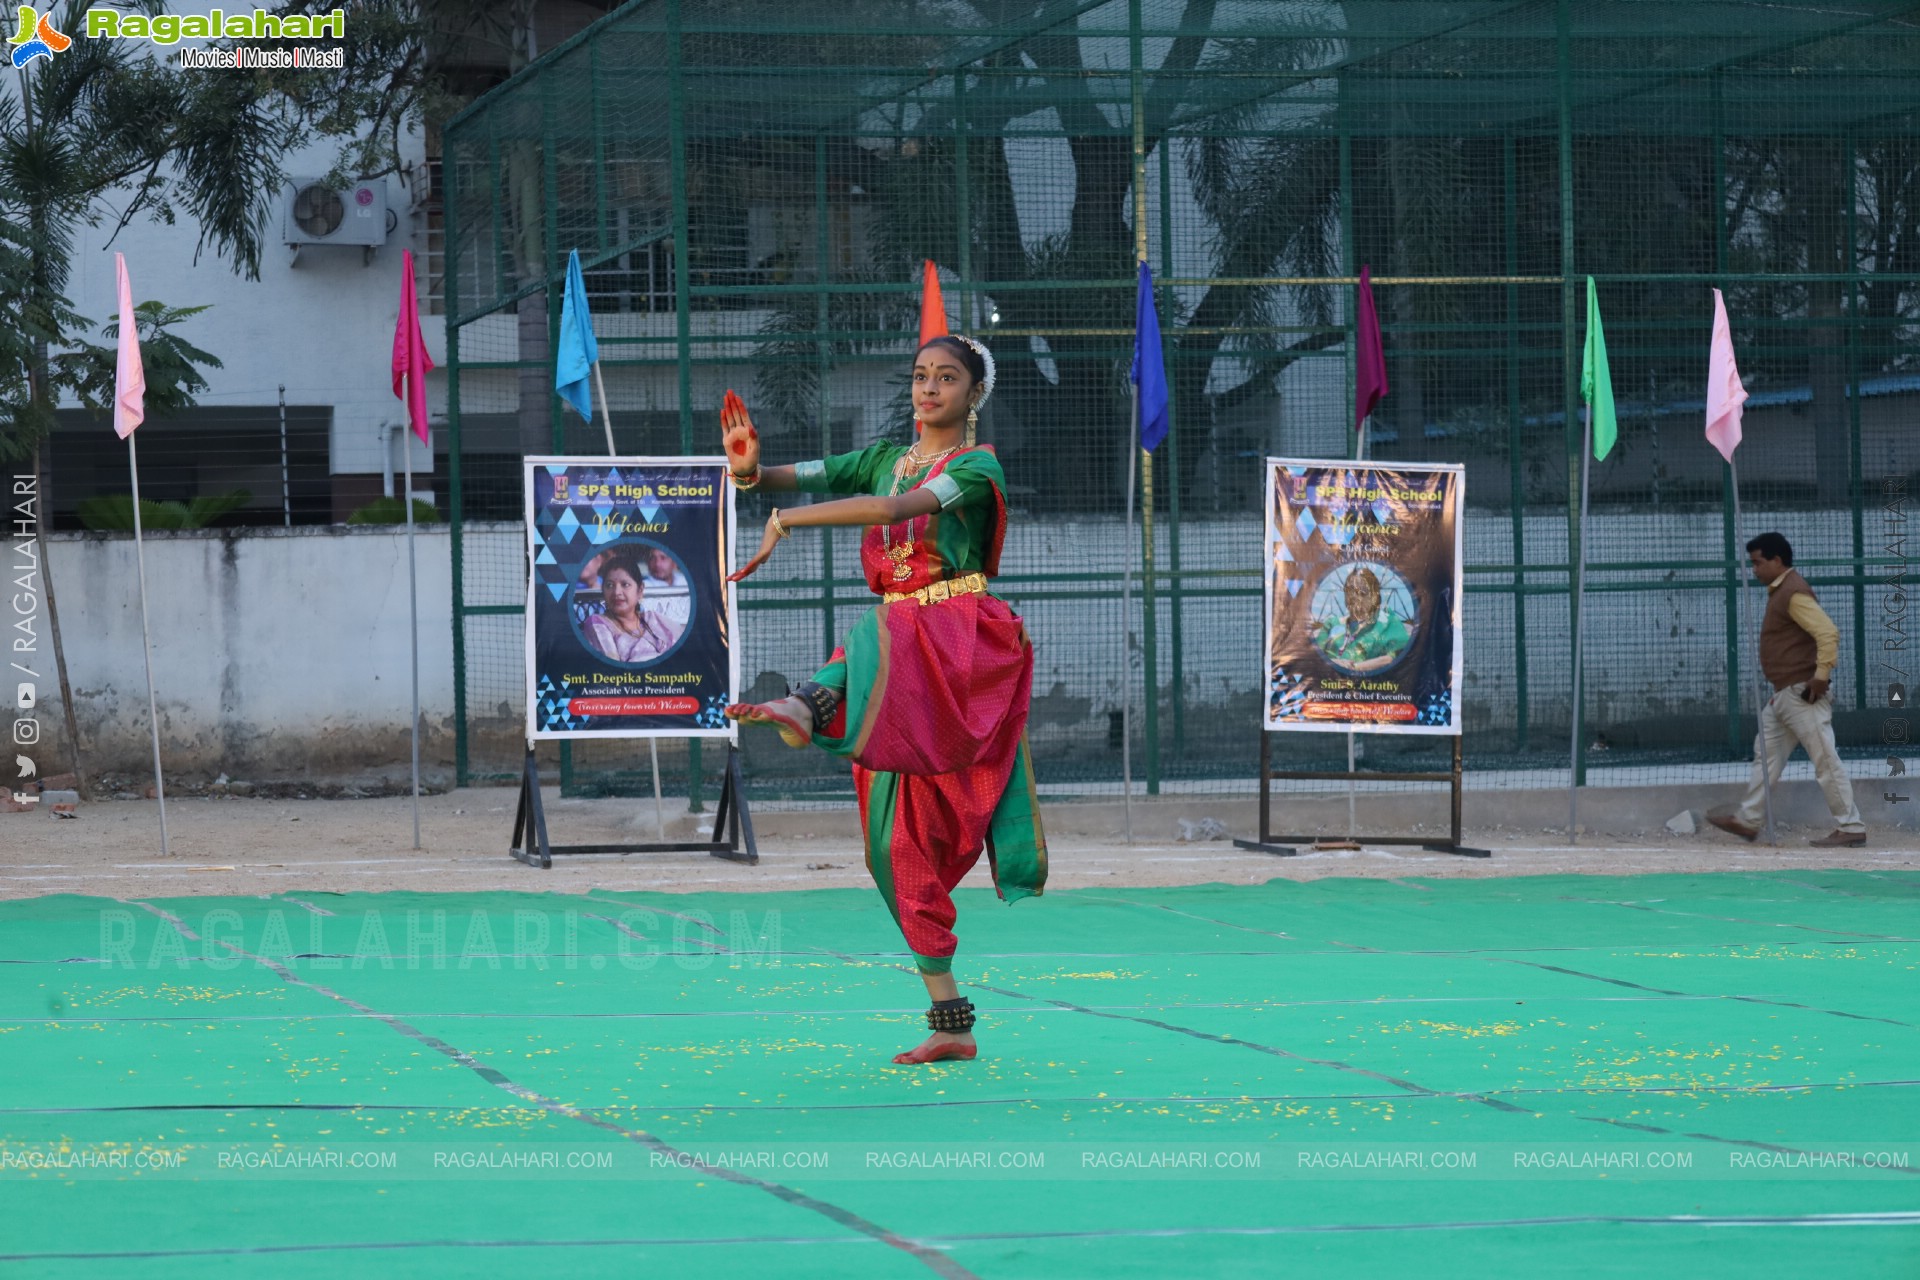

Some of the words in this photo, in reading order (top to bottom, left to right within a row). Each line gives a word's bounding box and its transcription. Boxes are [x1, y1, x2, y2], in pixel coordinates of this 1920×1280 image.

[357, 209, 371, 218] LG
[578, 485, 610, 496] SPS
[615, 485, 652, 499] High
[657, 485, 712, 496] School
[1315, 486, 1345, 497] SPS
[1350, 487, 1387, 502] High
[1391, 488, 1442, 501] School
[593, 512, 669, 534] Welcomes
[563, 674, 589, 684] Smt.
[593, 673, 641, 686] Deepika
[645, 672, 702, 685] Sampathy
[1321, 679, 1345, 689] Smt.
[1346, 680, 1356, 690] S.
[1358, 680, 1399, 693] Aarathy
[581, 686, 622, 695] Associate
[624, 686, 643, 695] Vice
[645, 686, 685, 694] President
[1307, 690, 1342, 699] President
[1344, 691, 1351, 699] &
[1353, 691, 1374, 700] Chief
[1376, 692, 1412, 701] Executive
[624, 702, 656, 710] towards
[658, 700, 692, 710] Wisdom
